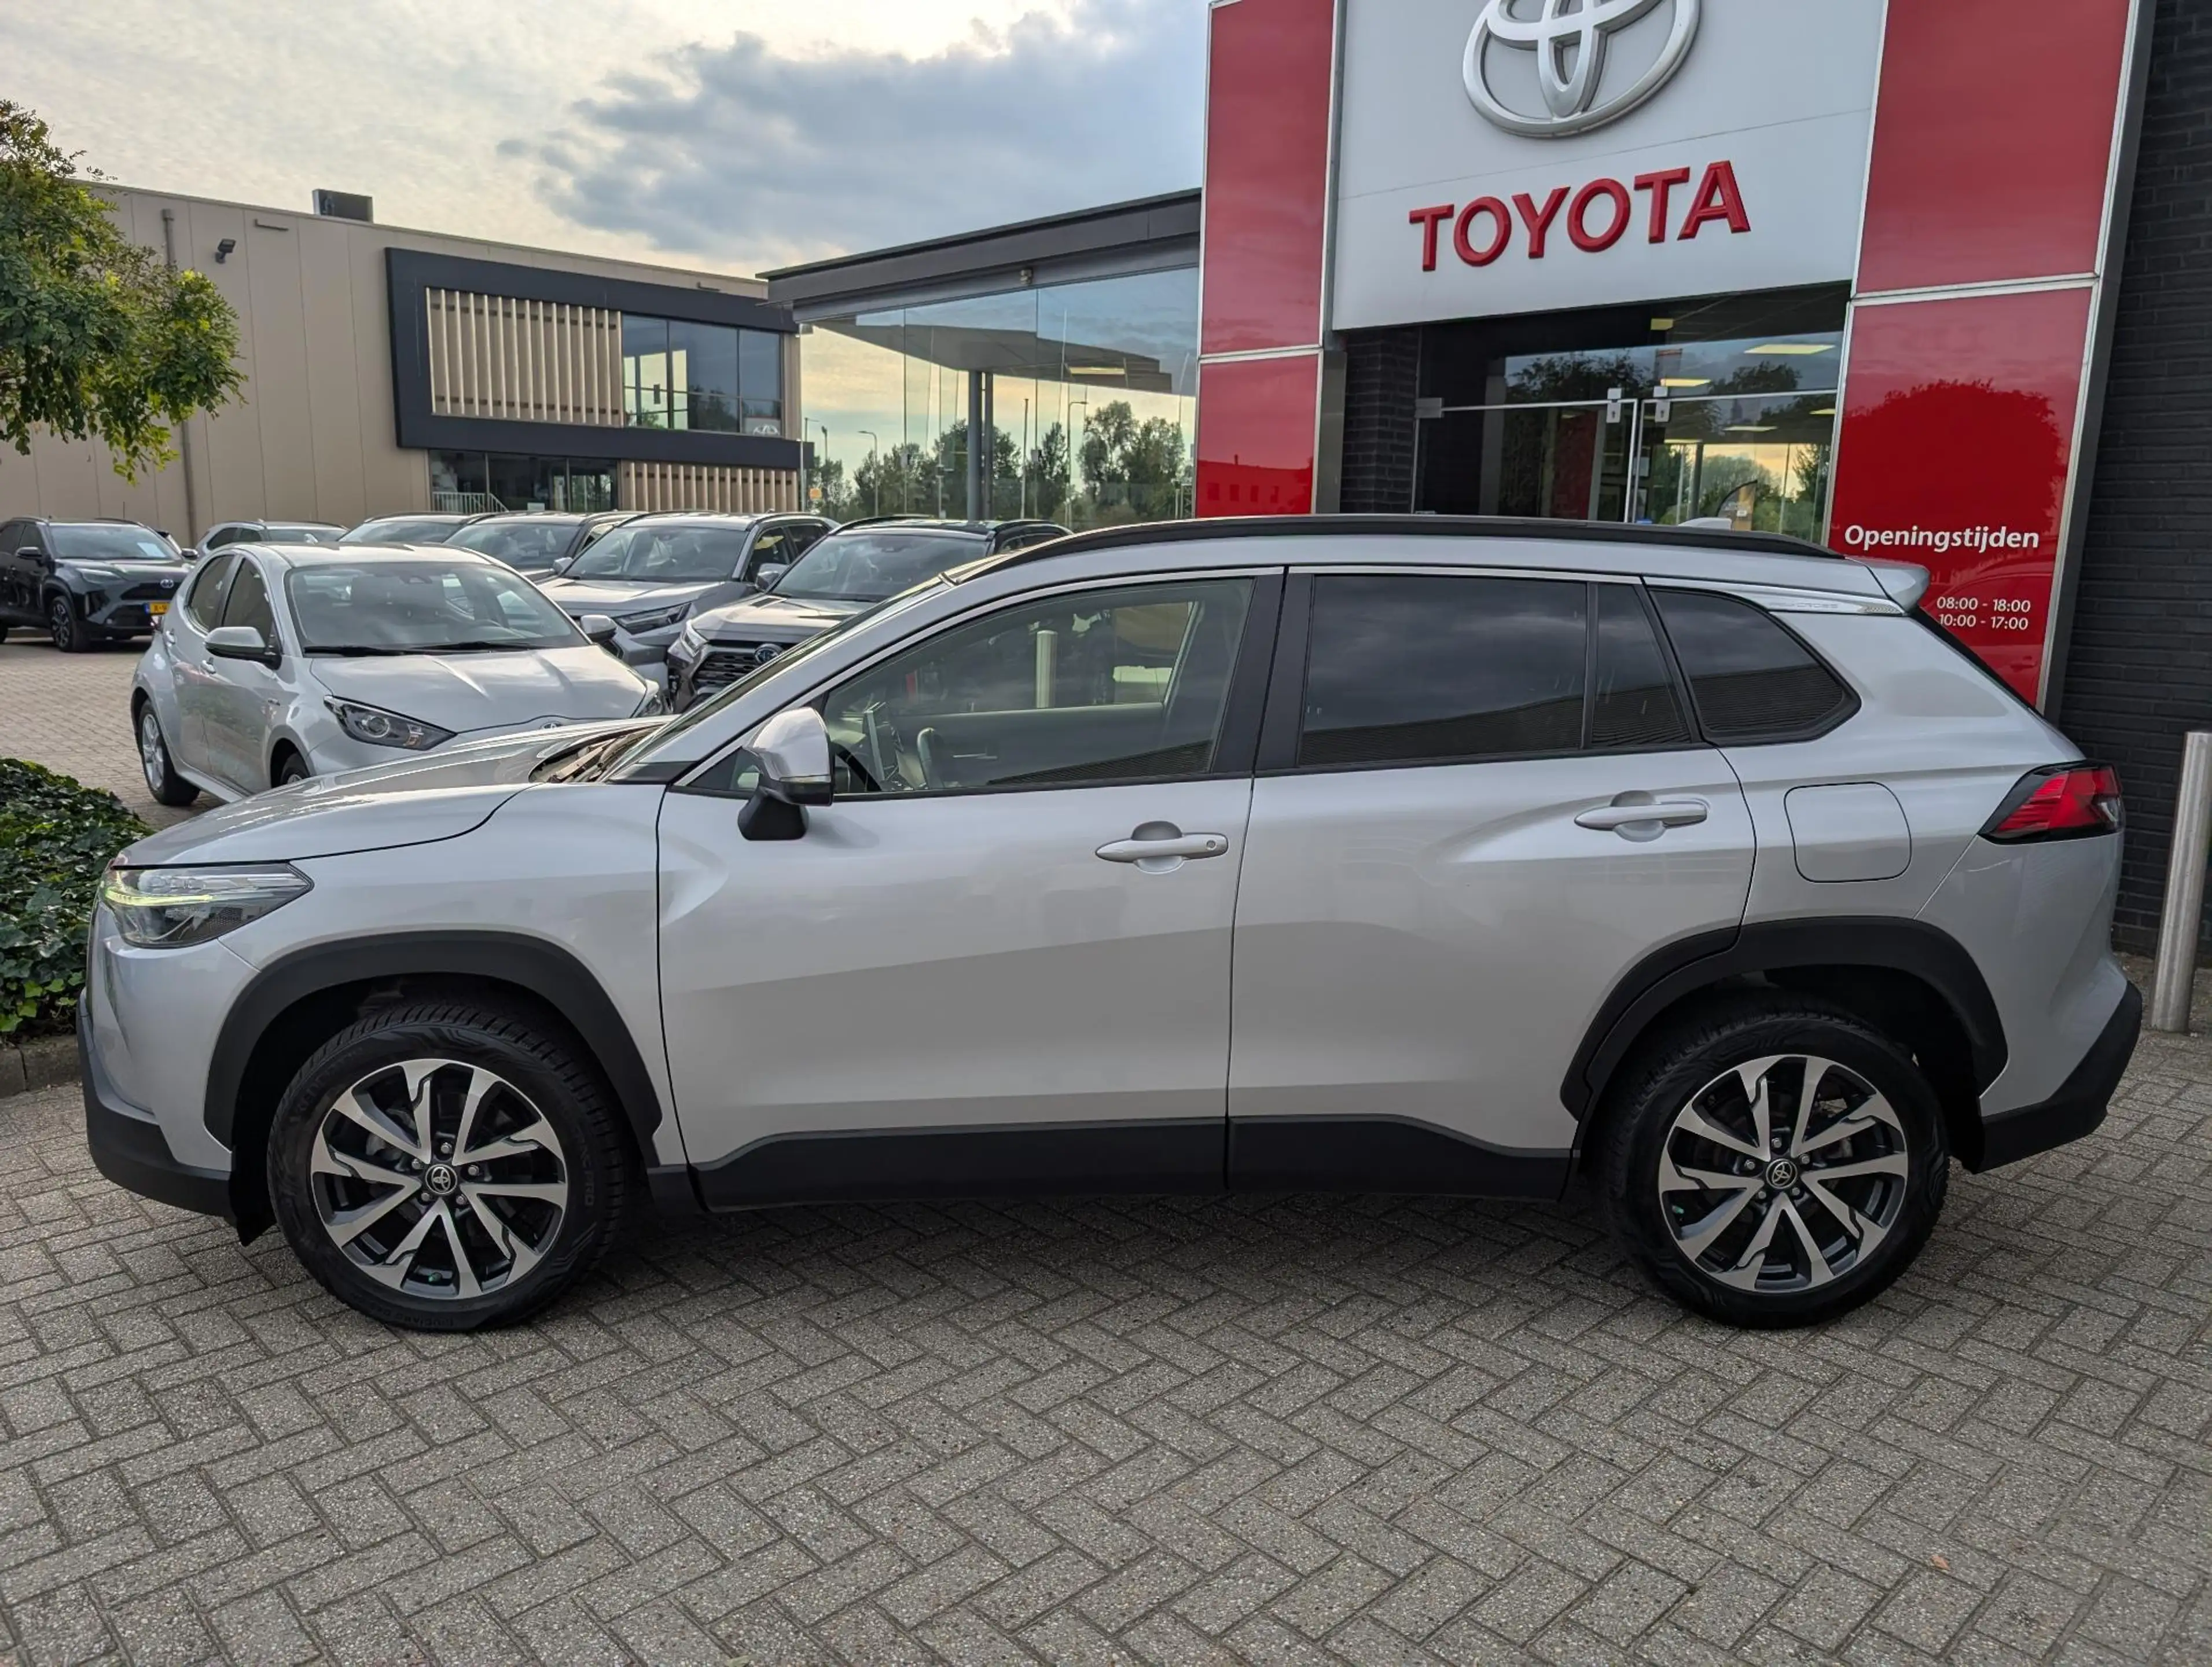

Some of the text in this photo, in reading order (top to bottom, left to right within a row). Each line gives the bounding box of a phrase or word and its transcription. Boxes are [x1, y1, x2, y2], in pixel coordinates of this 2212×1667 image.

[1409, 160, 1751, 271] TOYOTA
[1844, 525, 2040, 553] Openingstijden
[1937, 596, 1978, 610] 08:00
[1992, 598, 2031, 612] 18:00
[1938, 614, 1976, 627] 10:00
[1990, 616, 2029, 630] 17:00
